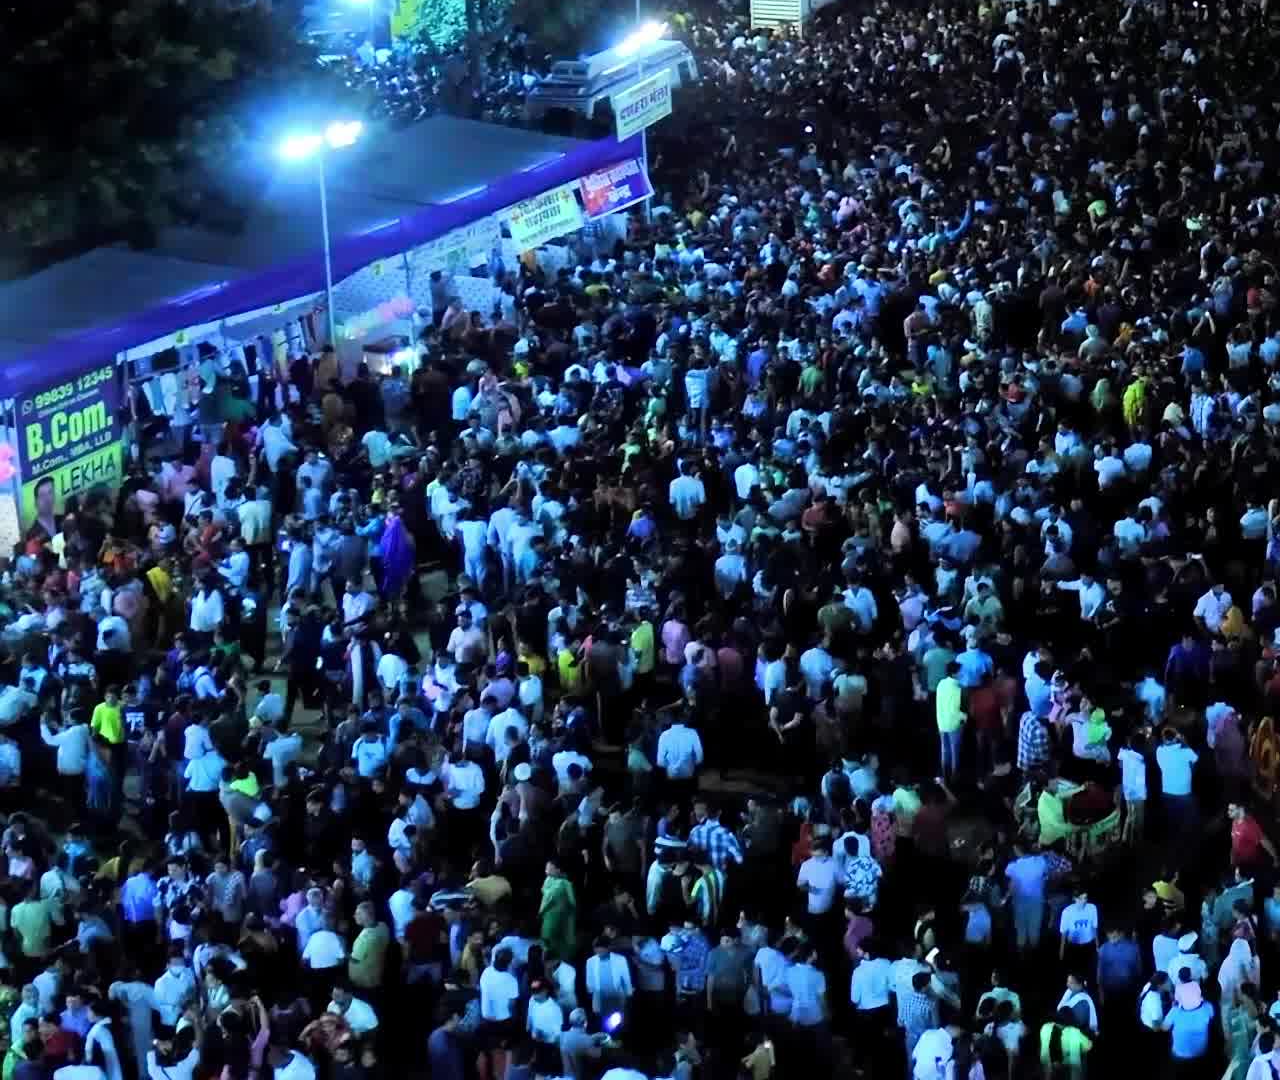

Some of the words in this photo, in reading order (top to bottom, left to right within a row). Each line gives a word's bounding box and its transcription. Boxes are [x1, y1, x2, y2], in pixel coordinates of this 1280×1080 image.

[77, 366, 113, 391] 12345
[25, 400, 114, 462] B.Com.
[60, 453, 116, 496] LEKHA
